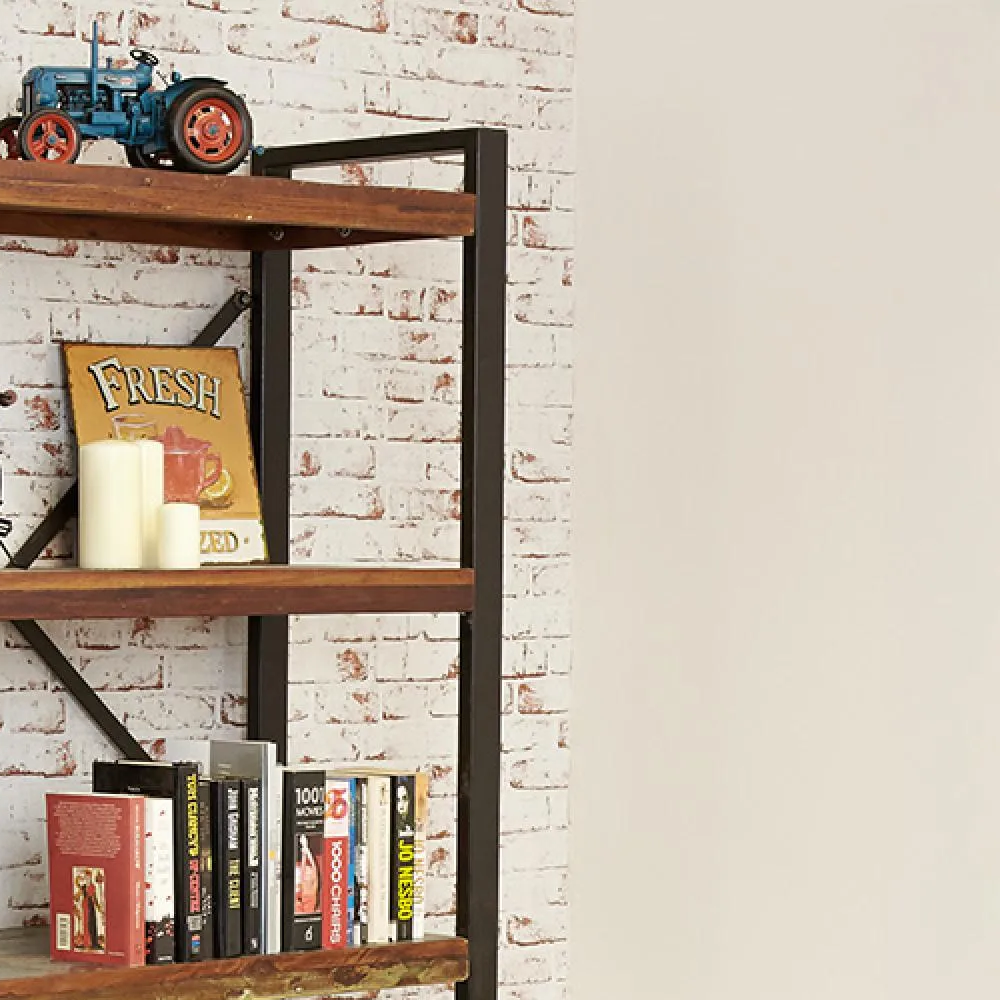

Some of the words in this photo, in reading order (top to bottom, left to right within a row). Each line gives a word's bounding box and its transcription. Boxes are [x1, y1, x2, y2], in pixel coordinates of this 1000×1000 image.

[88, 356, 221, 420] FRESH
[331, 841, 342, 882] 1000
[400, 840, 414, 862] JO
[330, 884, 342, 944] CHAIRS
